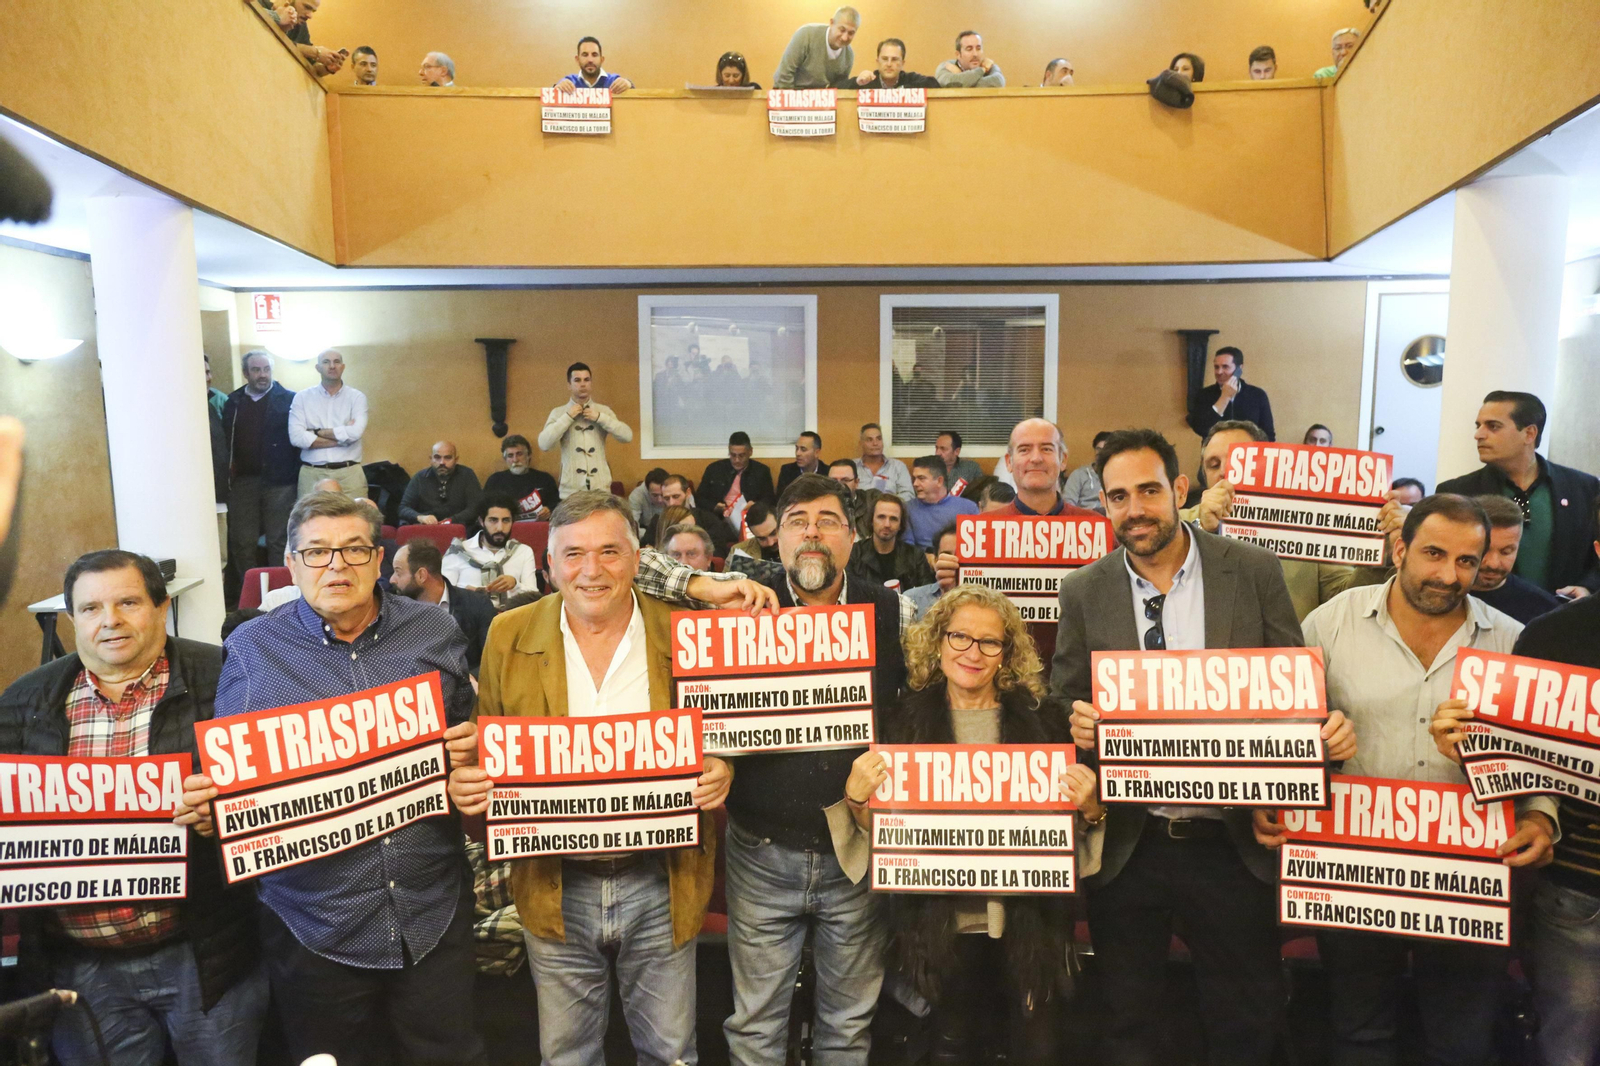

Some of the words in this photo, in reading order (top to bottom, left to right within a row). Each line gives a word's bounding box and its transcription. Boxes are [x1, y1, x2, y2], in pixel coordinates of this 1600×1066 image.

[542, 88, 555, 103] SE
[769, 89, 781, 107] SE
[783, 89, 835, 107] TRASPASA
[859, 89, 871, 103] SE
[874, 88, 925, 103] TRASPASA
[1228, 447, 1258, 485] SE
[1263, 448, 1389, 497] TRASPASA
[1232, 497, 1250, 505] AZÓN:
[1316, 513, 1330, 527] DE
[960, 519, 990, 558] SE
[991, 520, 1107, 560] TRASPASA
[1226, 527, 1258, 536] CONTACTO:
[1306, 543, 1321, 557] DE
[1323, 545, 1337, 558] LA
[1341, 547, 1379, 562] TORRE
[1045, 578, 1057, 590] DE
[1038, 607, 1051, 619] DE
[677, 617, 713, 669] SE
[718, 610, 870, 667] TRASPASA
[684, 684, 712, 694] RAZÓN:
[1097, 657, 1136, 712] SE
[1142, 655, 1318, 711] TRASPASA
[1456, 655, 1506, 717] SE
[683, 690, 788, 710] AYUNTAMIENTO
[793, 689, 809, 706] DE
[813, 685, 867, 705] MÁLAGA
[204, 722, 258, 786] SE
[256, 681, 441, 774] TRASPASA
[702, 728, 782, 750] FRANCISCO
[786, 727, 803, 744] DE
[807, 726, 822, 743] LA
[825, 723, 869, 741] TORRE
[1105, 727, 1134, 738] RAZÓN:
[484, 723, 524, 778] SE
[528, 715, 697, 775] TRASPASA
[1104, 739, 1221, 758] AYUNTAMIENTO
[1225, 739, 1245, 758] DE
[1249, 736, 1317, 758] MÁLAGA
[1463, 734, 1594, 775] AYUNTAMIENTO
[875, 750, 909, 803] SE
[915, 750, 1070, 803] TRASPASA
[1106, 769, 1151, 779] CONTACTO:
[1471, 762, 1509, 776] CONTACTO:
[0, 761, 183, 813] TRASPASA
[493, 790, 522, 799] RAZÓN:
[1106, 780, 1121, 798] D.
[1125, 780, 1214, 800] FRANCISCO
[1219, 781, 1238, 800] DE
[1242, 782, 1262, 800] LA
[1265, 783, 1319, 802] TORRE
[1475, 777, 1488, 796] D.
[1488, 772, 1580, 795] FRANCISCO
[224, 798, 259, 814] RAZÓN:
[225, 785, 355, 834] AYUNTAMIENTO
[358, 778, 377, 798] DE
[380, 757, 440, 792] MÁLAGA
[492, 797, 607, 816] AYUNTAMIENTO
[611, 796, 629, 812] DE
[633, 791, 693, 810] MÁLAGA
[879, 817, 906, 827] RAZÓN:
[1331, 782, 1508, 849] TRASPASA
[232, 856, 251, 876] D.
[254, 827, 351, 870] FRANCISCO
[355, 819, 374, 838] DE
[377, 813, 395, 832] LA
[397, 794, 444, 823] TORRE
[493, 827, 539, 837] CONTACTO:
[494, 838, 509, 855] D.
[513, 833, 599, 854] FRANCISCO
[603, 832, 622, 848] DE
[625, 830, 643, 846] LA
[646, 827, 693, 844] TORRE
[878, 828, 984, 846] AYUNTAMIENTO
[988, 829, 1005, 846] DE
[1009, 826, 1068, 847] MÁLAGA
[89, 838, 109, 856] DE
[114, 834, 181, 855] MÁLAGA
[230, 835, 283, 856] CONTACTO:
[1289, 849, 1318, 859] RAZÓN:
[878, 857, 920, 867] CONTACTO:
[77, 880, 98, 898] DE
[103, 879, 122, 897] LA
[127, 876, 181, 895] TORRE
[878, 868, 891, 885] D.
[894, 868, 976, 887] FRANCISCO
[980, 869, 998, 887] DE
[1002, 870, 1019, 887] LA
[1022, 870, 1070, 888] TORRE
[1287, 859, 1406, 887] AYUNTAMIENTO
[1410, 870, 1430, 889] DE
[1435, 871, 1503, 897] MÁLAGA
[1287, 890, 1332, 902] CONTACTO:
[1287, 900, 1301, 919] D.
[1305, 902, 1395, 928] FRANCISCO
[1400, 912, 1420, 931] DE
[1425, 914, 1444, 934] LA
[1449, 917, 1504, 940] TORRE
